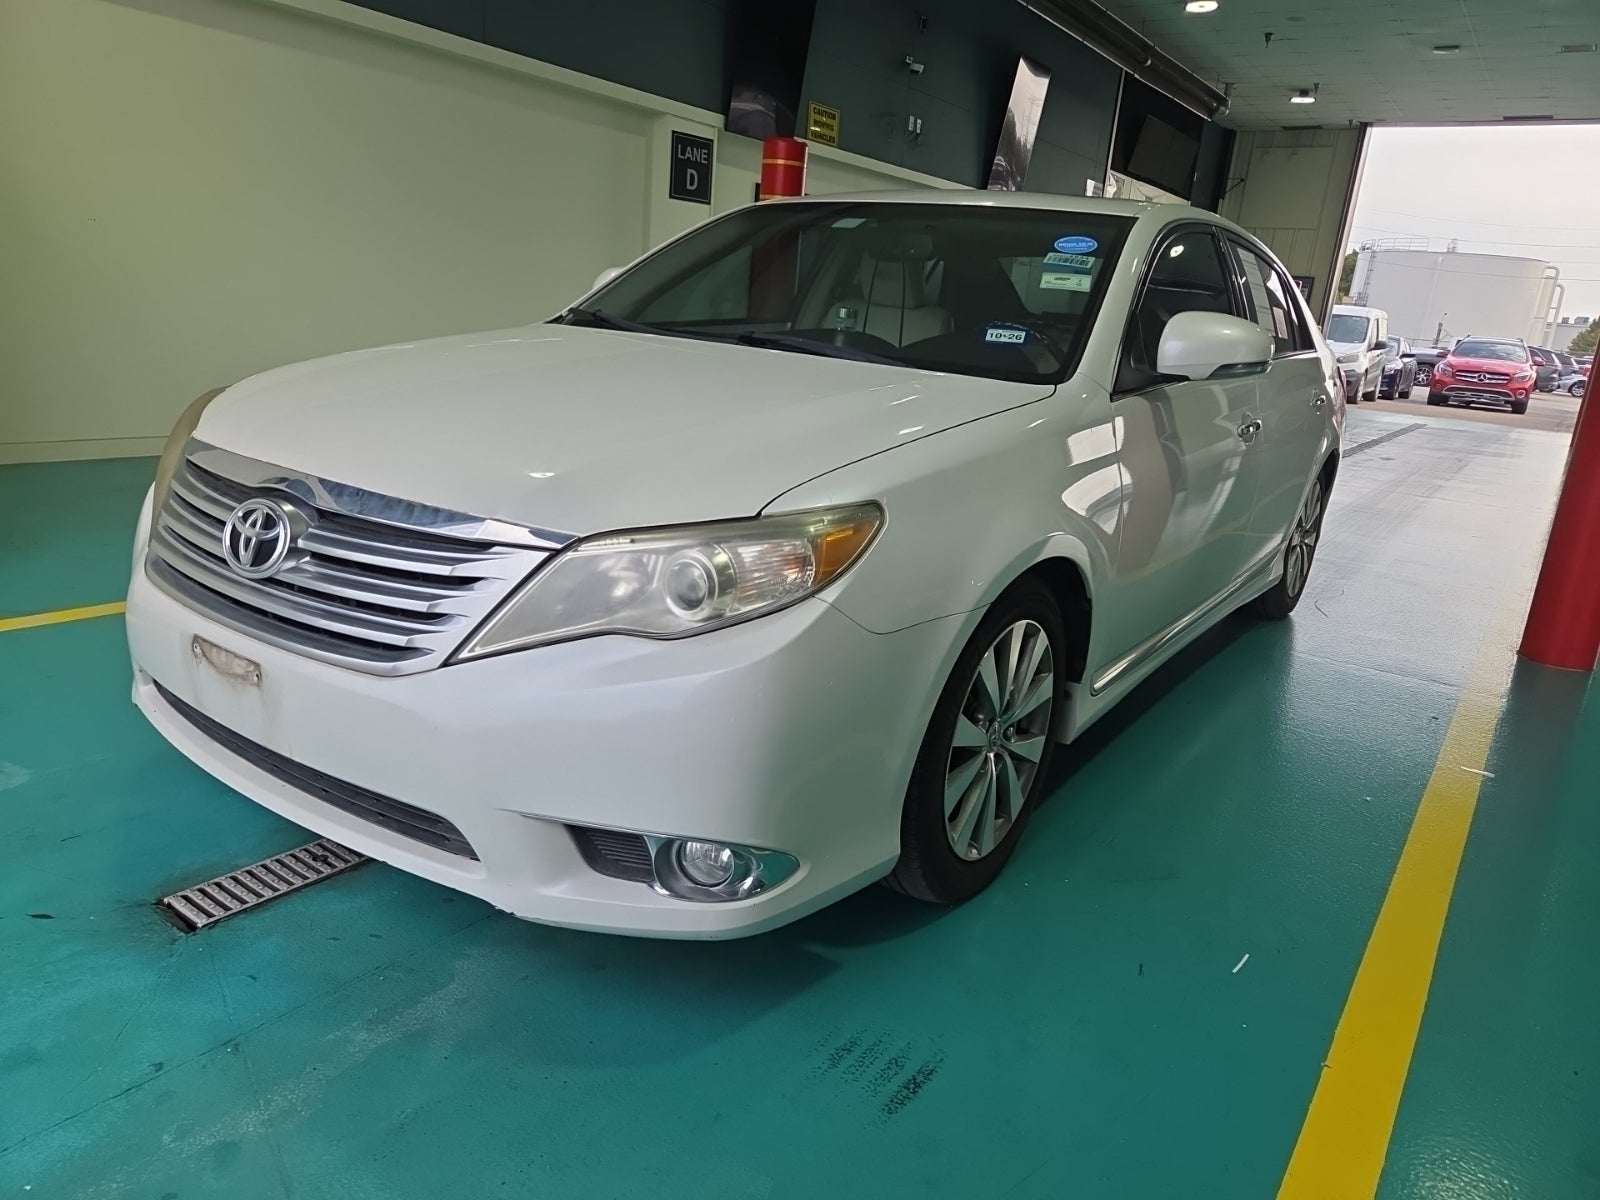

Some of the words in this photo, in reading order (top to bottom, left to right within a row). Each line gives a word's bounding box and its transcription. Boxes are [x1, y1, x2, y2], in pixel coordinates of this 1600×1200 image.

[813, 106, 836, 121] CAUTION
[811, 130, 836, 144] VEHICLES
[678, 143, 708, 164] LANE
[686, 168, 698, 190] D
